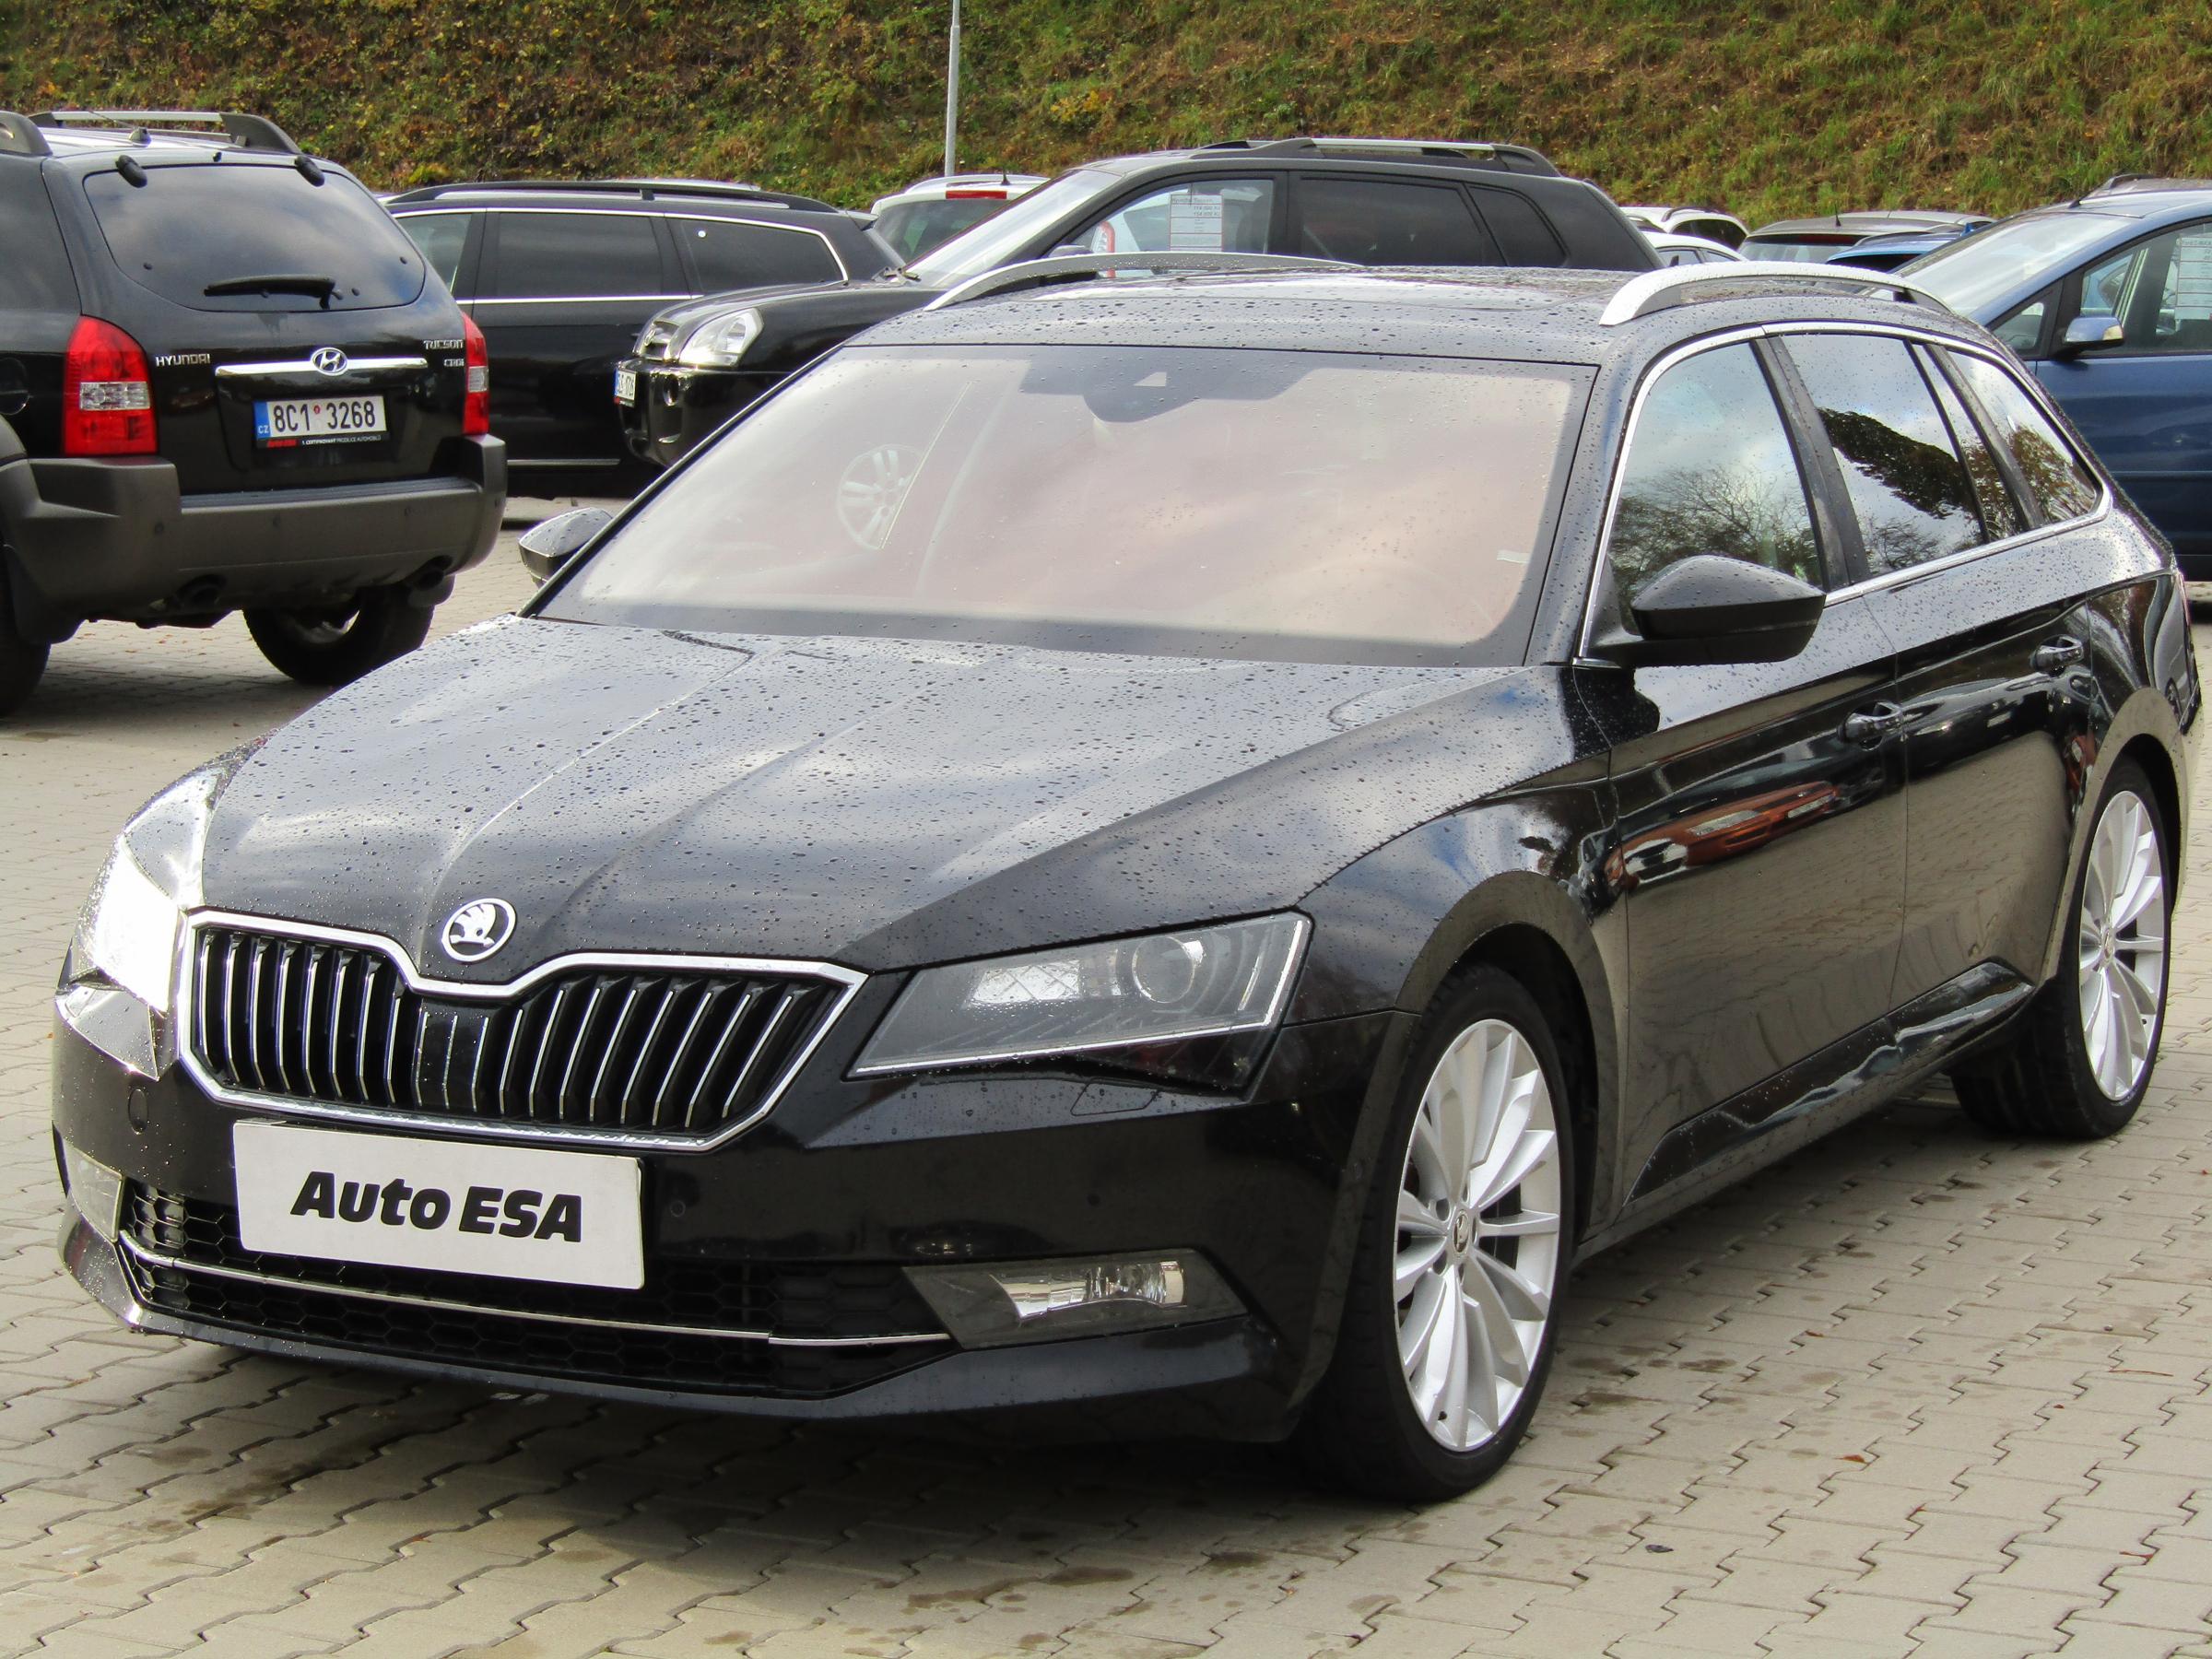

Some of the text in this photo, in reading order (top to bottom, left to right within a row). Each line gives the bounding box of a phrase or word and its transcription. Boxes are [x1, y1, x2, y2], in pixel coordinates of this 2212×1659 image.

[156, 353, 211, 367] HYUNDAI
[273, 400, 376, 432] 8C1 3268
[257, 425, 270, 435] CZ
[290, 1171, 582, 1243] Auto ESA
